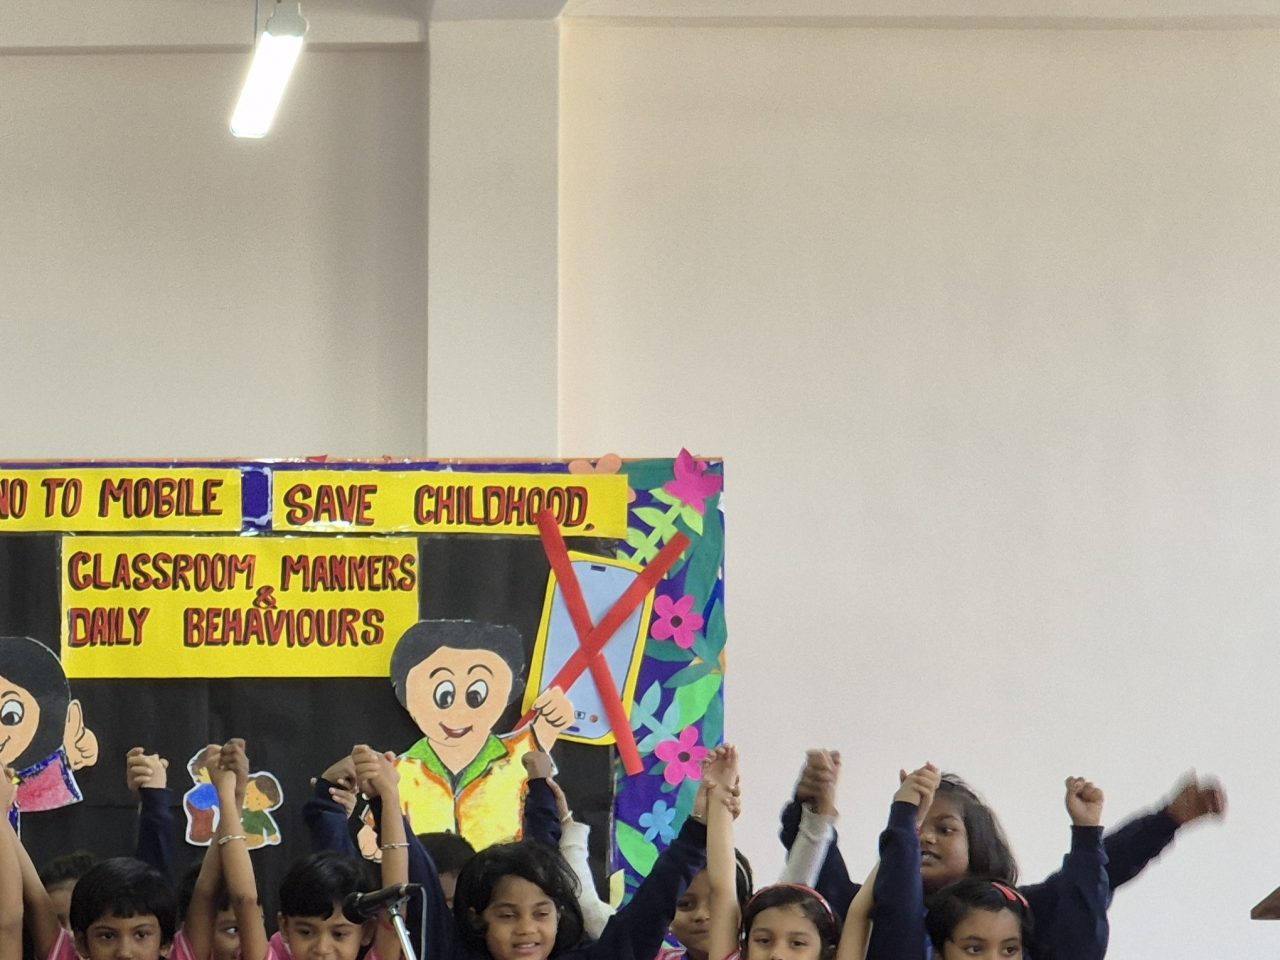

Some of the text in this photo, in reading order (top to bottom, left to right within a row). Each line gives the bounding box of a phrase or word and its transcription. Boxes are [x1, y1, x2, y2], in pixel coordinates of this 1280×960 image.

[40, 478, 82, 518] TO
[98, 477, 224, 518] MOBILE
[283, 483, 378, 526] SAVE
[68, 551, 416, 593] CLASSROOM MANNERS
[253, 585, 278, 609] &
[68, 606, 385, 648] DAILY BEHAVIOURS
